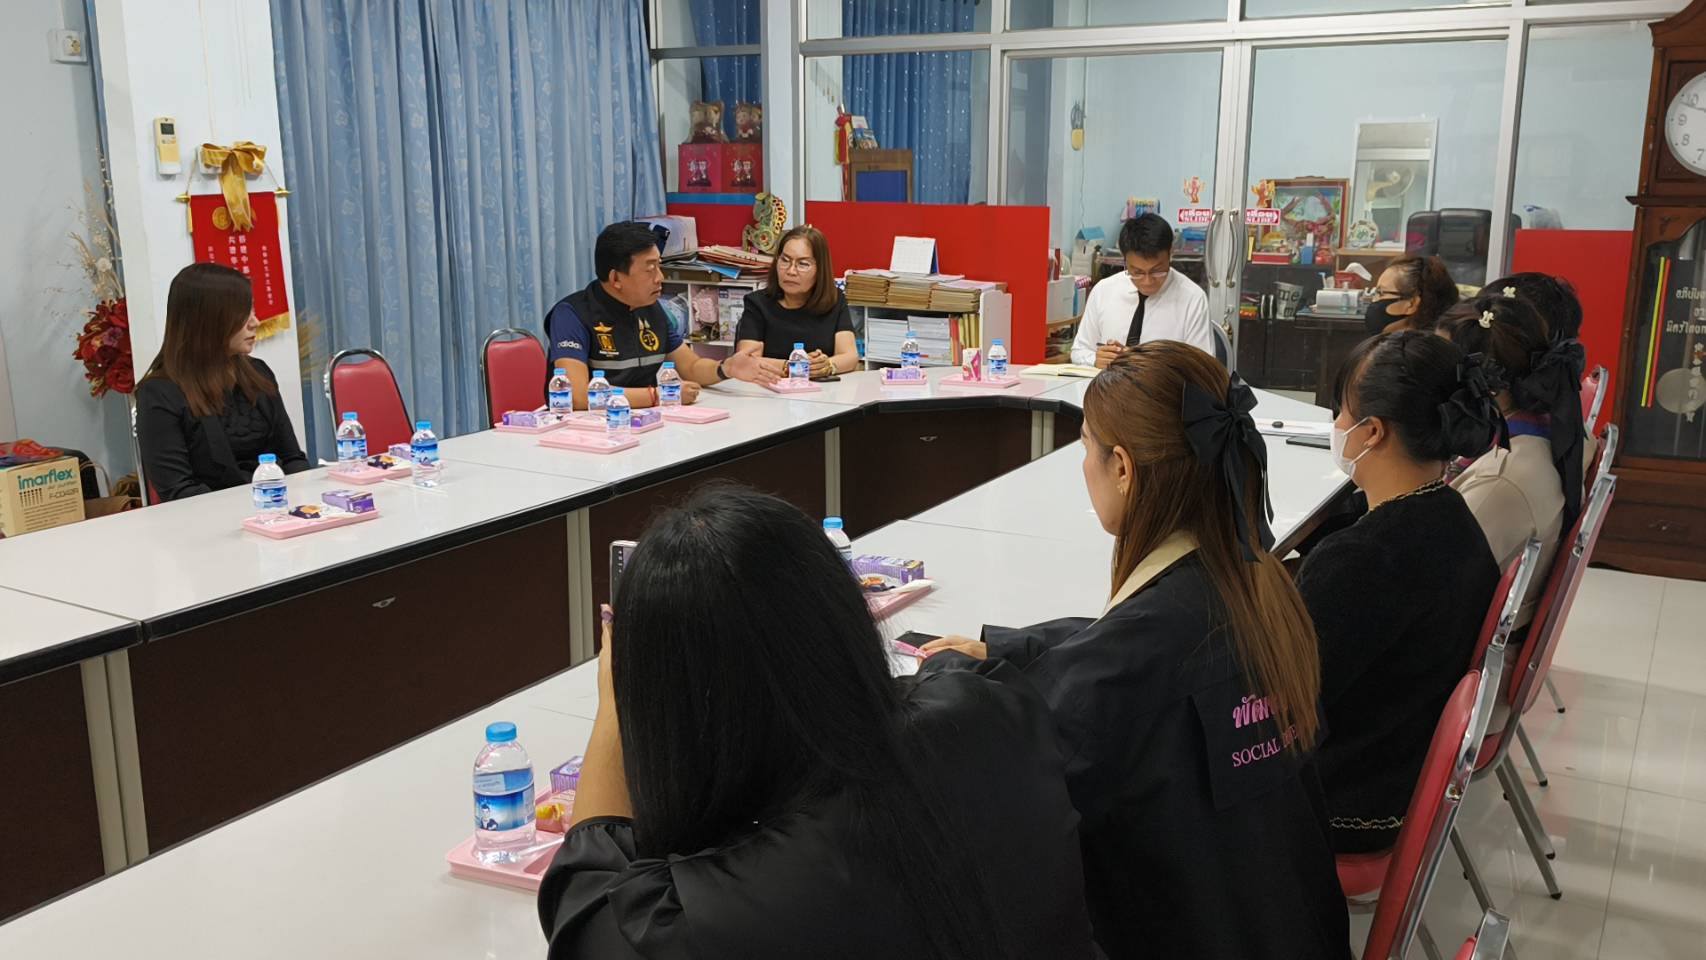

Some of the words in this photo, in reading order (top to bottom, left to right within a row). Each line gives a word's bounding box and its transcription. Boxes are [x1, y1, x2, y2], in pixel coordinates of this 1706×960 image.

[1678, 114, 1687, 126] 9
[1681, 134, 1690, 146] 8
[1696, 149, 1705, 161] 7
[17, 468, 73, 490] imarflex
[1231, 738, 1281, 767] SOCIAL
